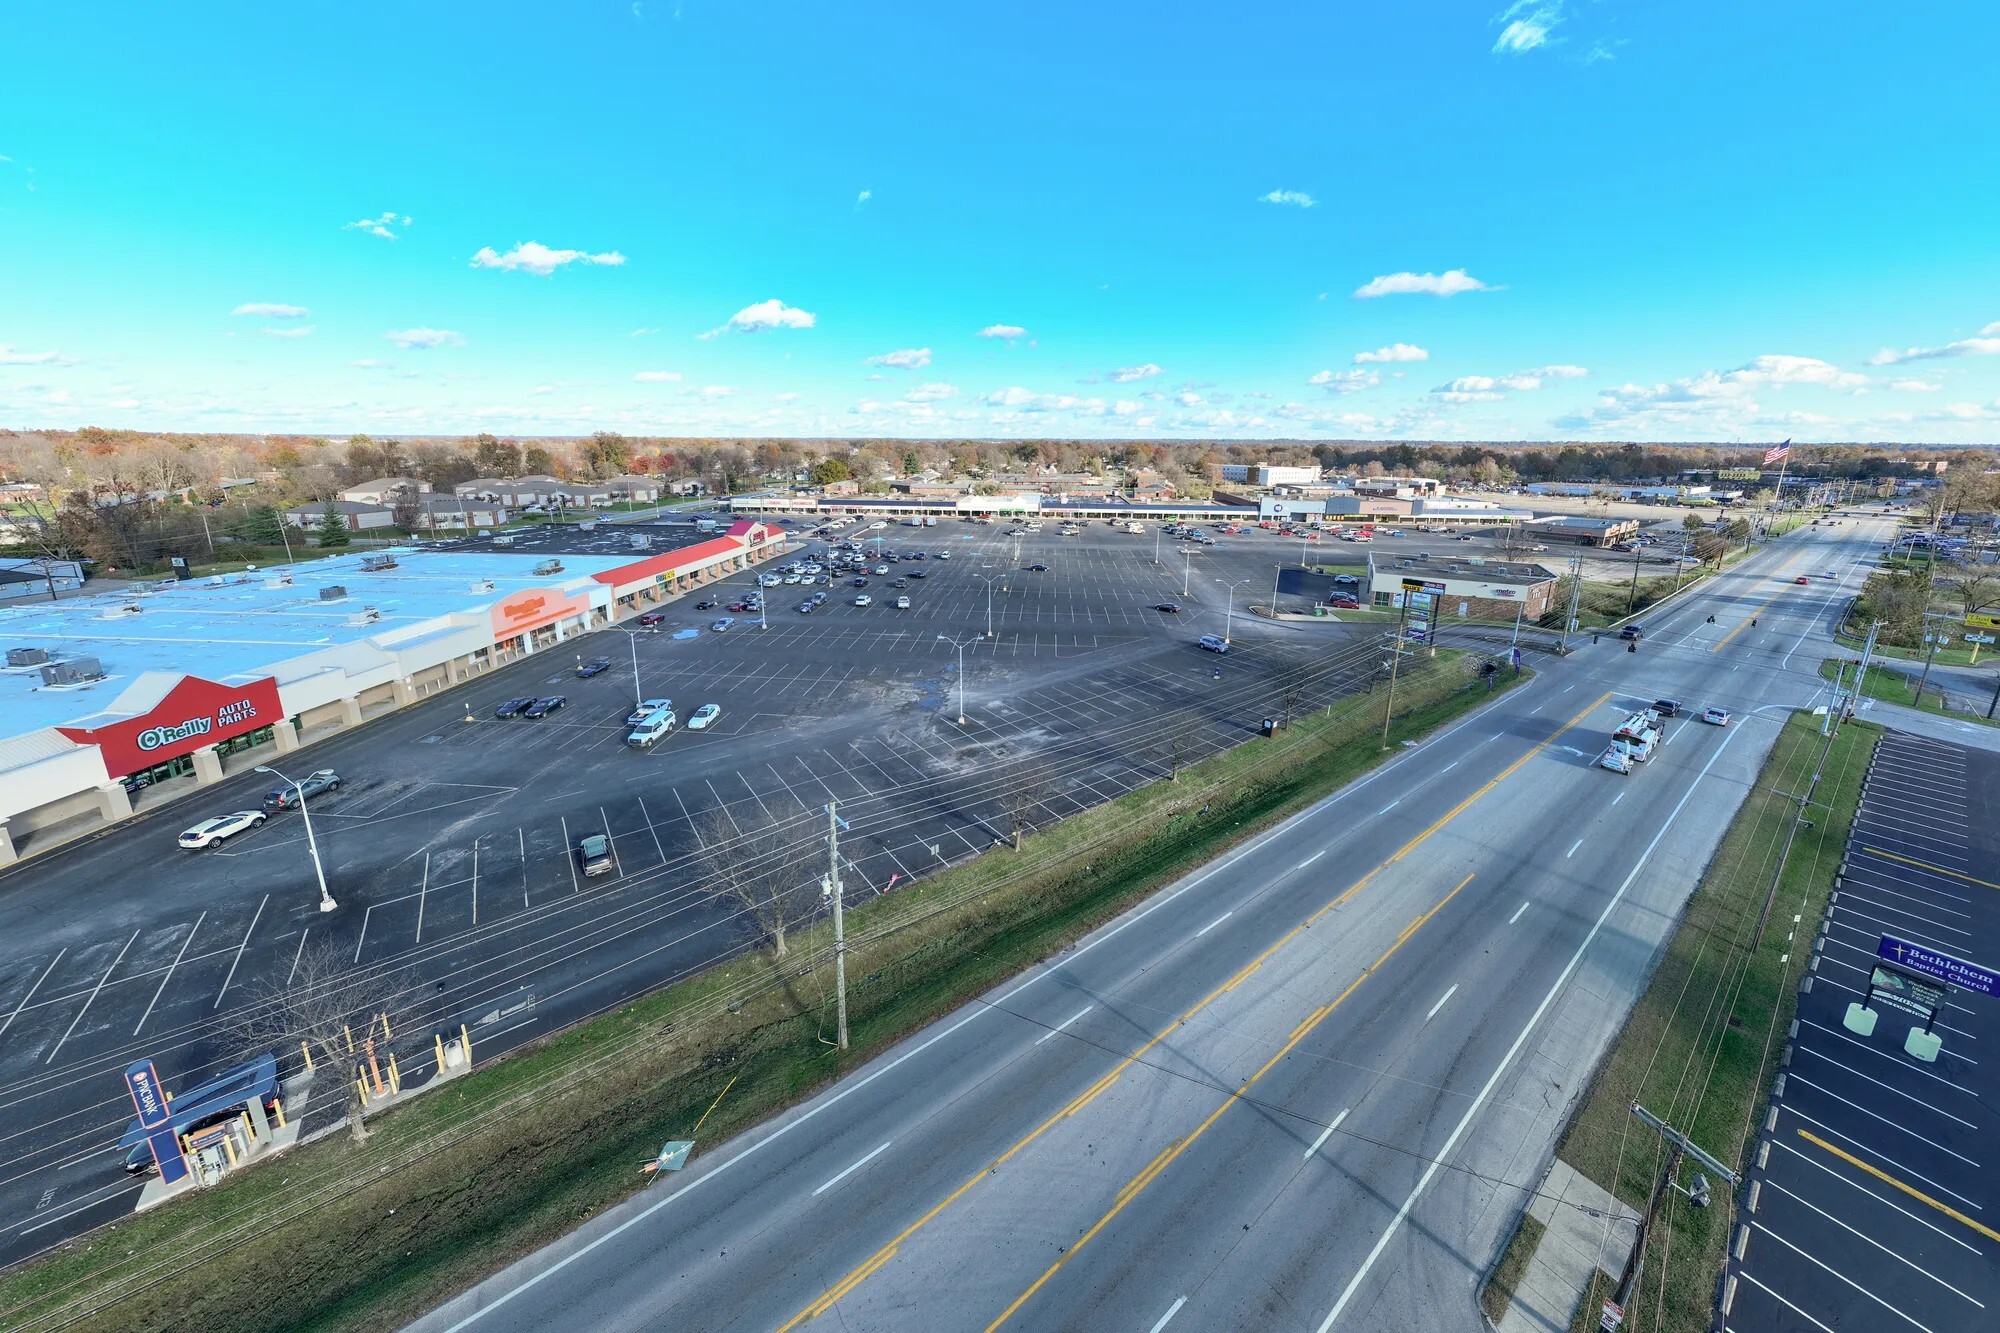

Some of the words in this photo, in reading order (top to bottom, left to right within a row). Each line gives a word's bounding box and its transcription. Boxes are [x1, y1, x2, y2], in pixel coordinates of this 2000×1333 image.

[217, 707, 257, 727] PARTS
[219, 699, 251, 717] AUTO
[138, 717, 211, 750] O'Reilly
[1906, 958, 1944, 976] Baptist
[1947, 973, 1990, 992] Church
[1908, 948, 1994, 984] Bethlehem
